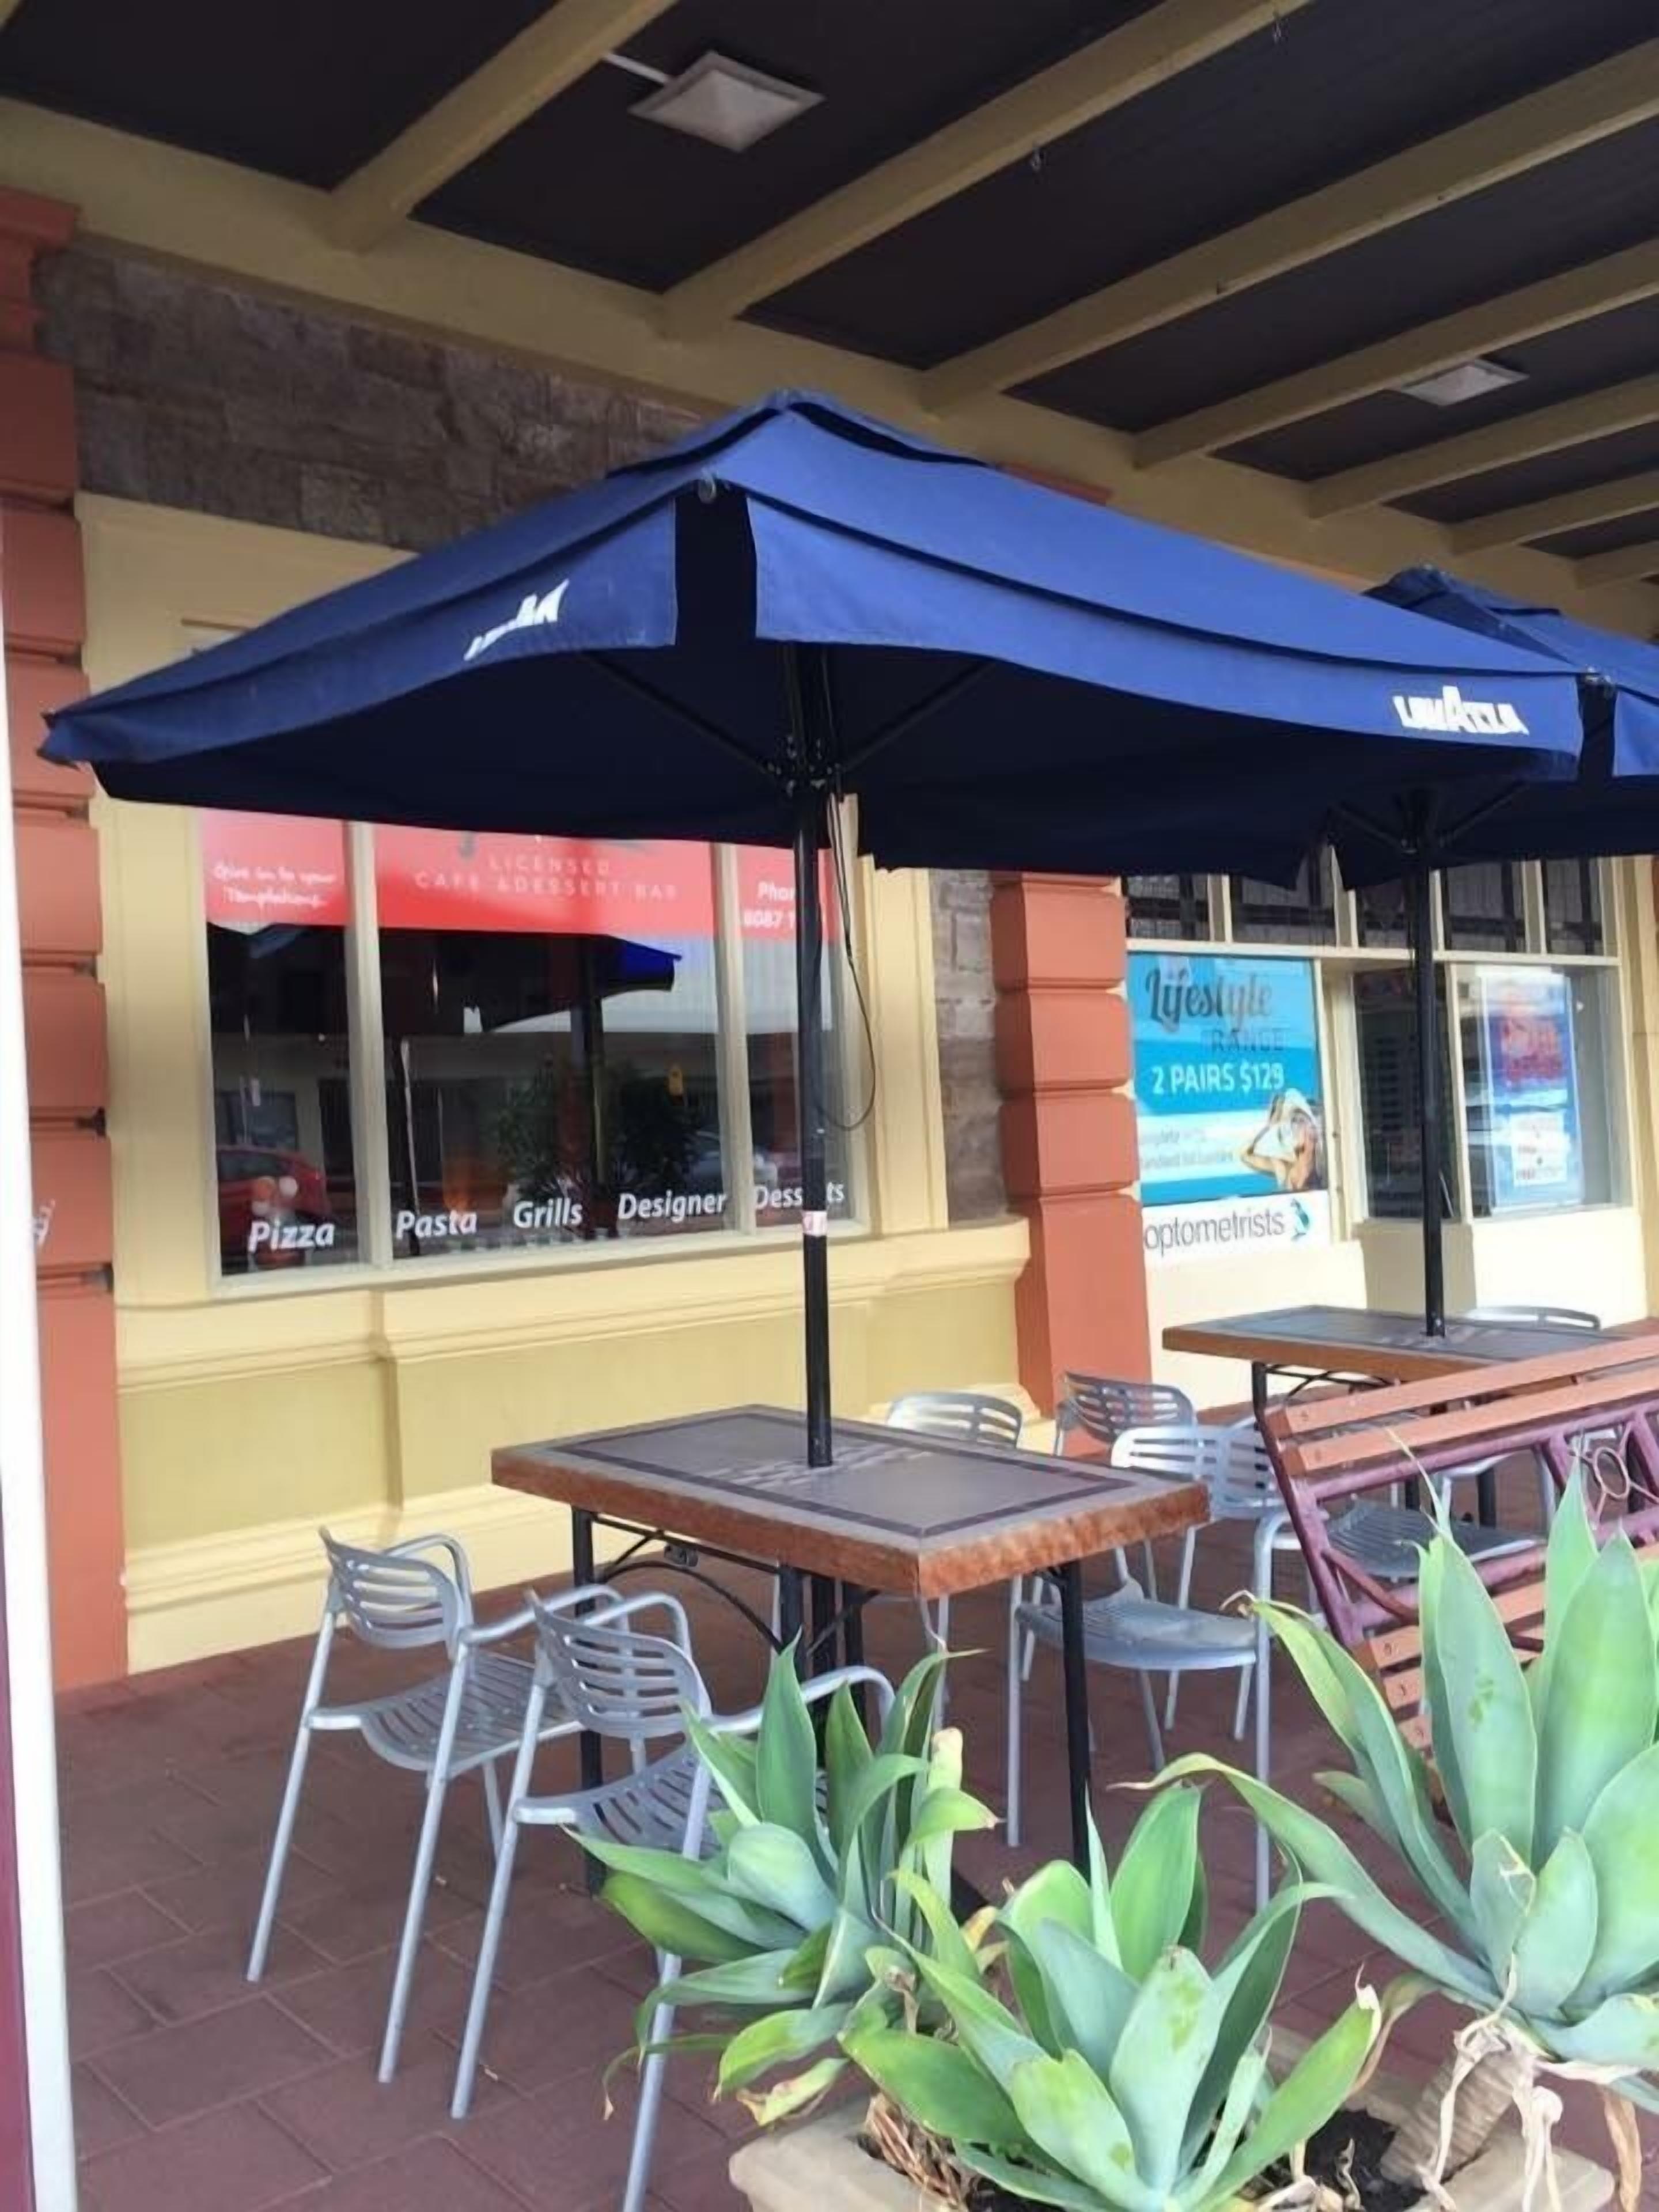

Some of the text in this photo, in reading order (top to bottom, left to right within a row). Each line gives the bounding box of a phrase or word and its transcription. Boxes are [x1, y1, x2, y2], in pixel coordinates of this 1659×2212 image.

[1392, 685, 1530, 736] LAVAZZA
[1146, 968, 1272, 1034] Lifestyle
[1152, 1059, 1285, 1094] 2 PAIRS $129
[247, 1181, 844, 1253] Pizza Pasta Grills Designer Dessts
[1145, 1207, 1285, 1258] optometrists
